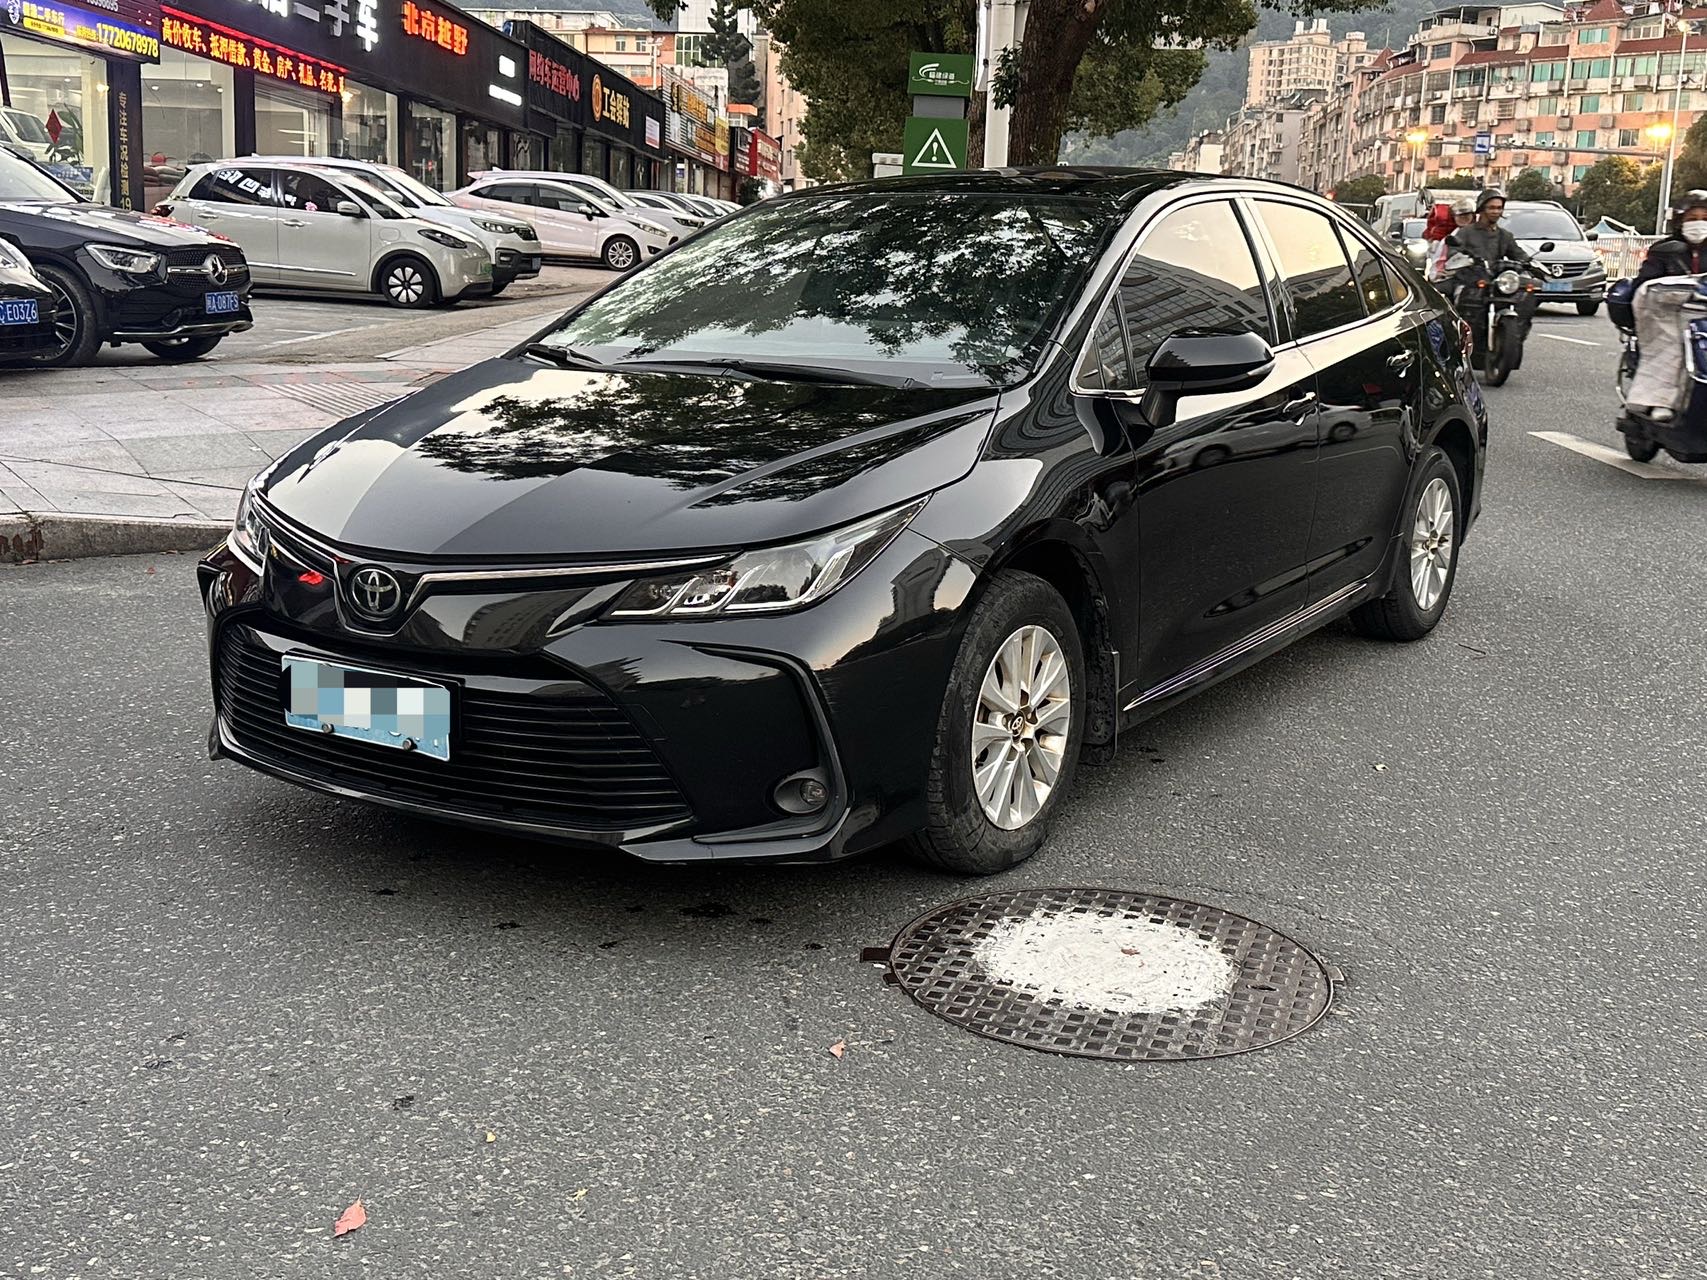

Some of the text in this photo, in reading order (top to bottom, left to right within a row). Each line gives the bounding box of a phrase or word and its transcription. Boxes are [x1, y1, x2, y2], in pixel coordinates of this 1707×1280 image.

[97, 22, 158, 58] 17720678978
[401, 1, 469, 56] 北京越野
[528, 49, 581, 102] 网约车运营中心
[602, 87, 631, 129] 工会驿站
